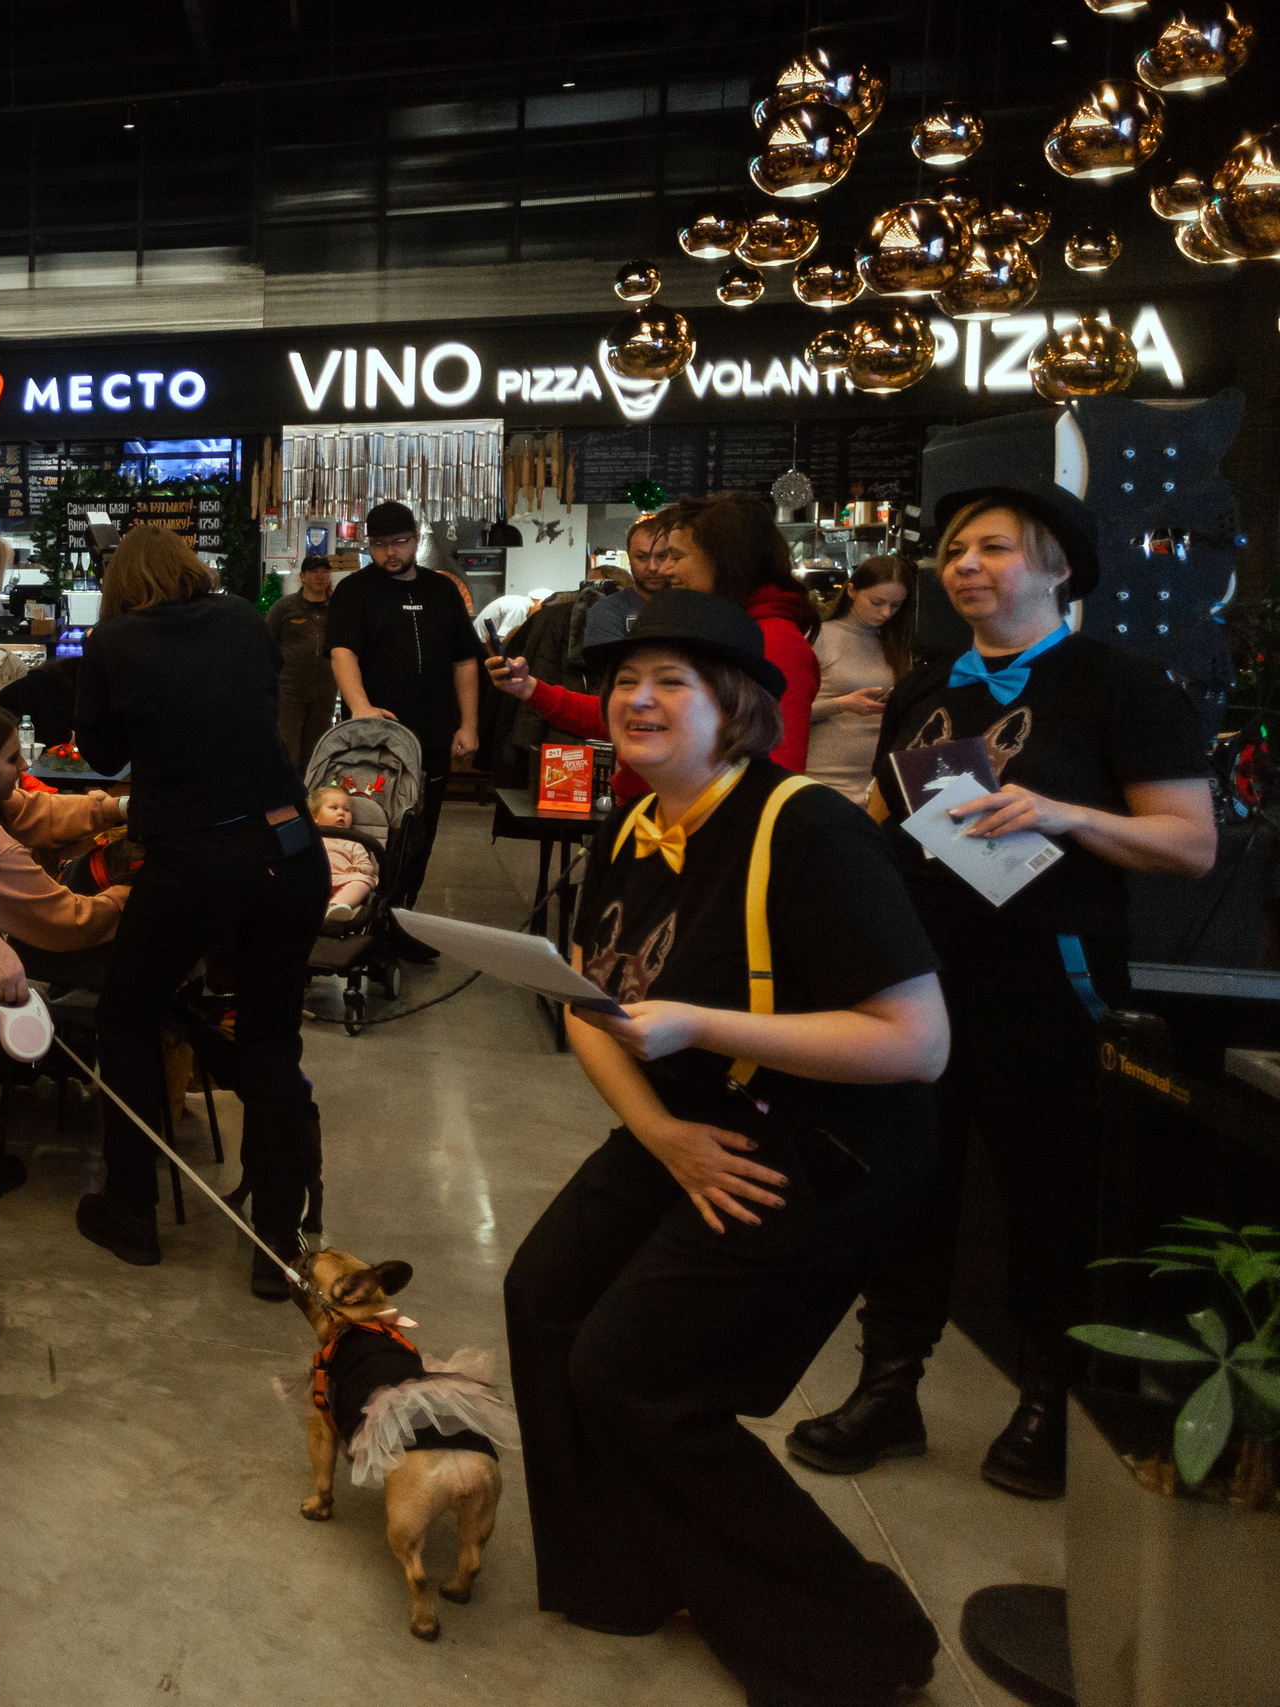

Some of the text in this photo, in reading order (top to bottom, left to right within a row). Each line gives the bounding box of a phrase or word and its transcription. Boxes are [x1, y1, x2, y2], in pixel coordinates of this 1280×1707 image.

[929, 304, 1185, 391] PIZA
[23, 370, 207, 412] МЕСТО
[289, 342, 482, 411] VINO
[497, 366, 604, 403] PIZZA
[686, 355, 855, 399] VOLANT
[199, 501, 220, 513] 1650
[199, 518, 220, 530] 1750
